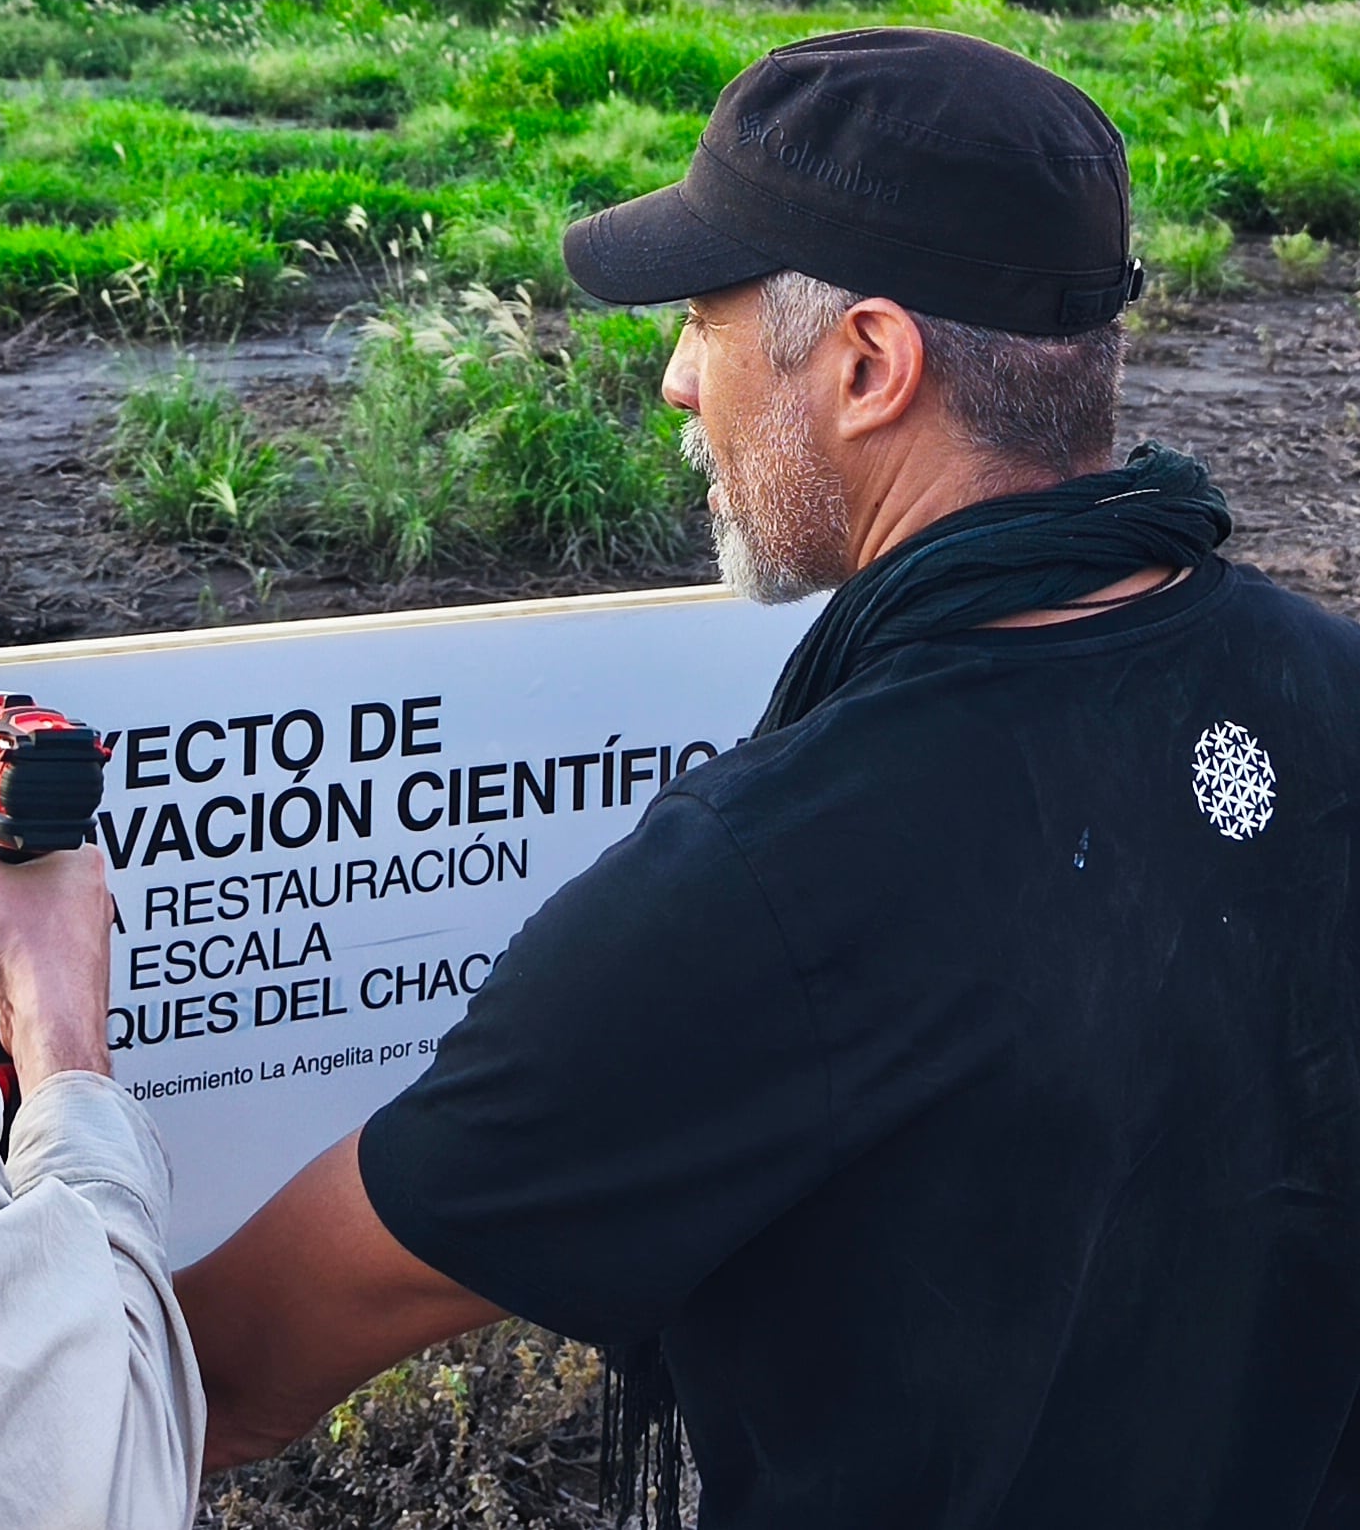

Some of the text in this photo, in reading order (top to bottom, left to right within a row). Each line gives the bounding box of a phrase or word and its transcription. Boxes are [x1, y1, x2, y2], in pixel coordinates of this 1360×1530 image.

[759, 124, 901, 205] Columbia
[349, 695, 442, 763] DE
[397, 734, 750, 832] CIENTÍFI
[144, 832, 528, 931] RESTAURACIÓN
[129, 922, 332, 991] ESCALA
[106, 949, 508, 1051] QUES DEL CHAC
[260, 1061, 286, 1081] La
[292, 1045, 374, 1076] Angelita
[380, 1041, 413, 1066] por
